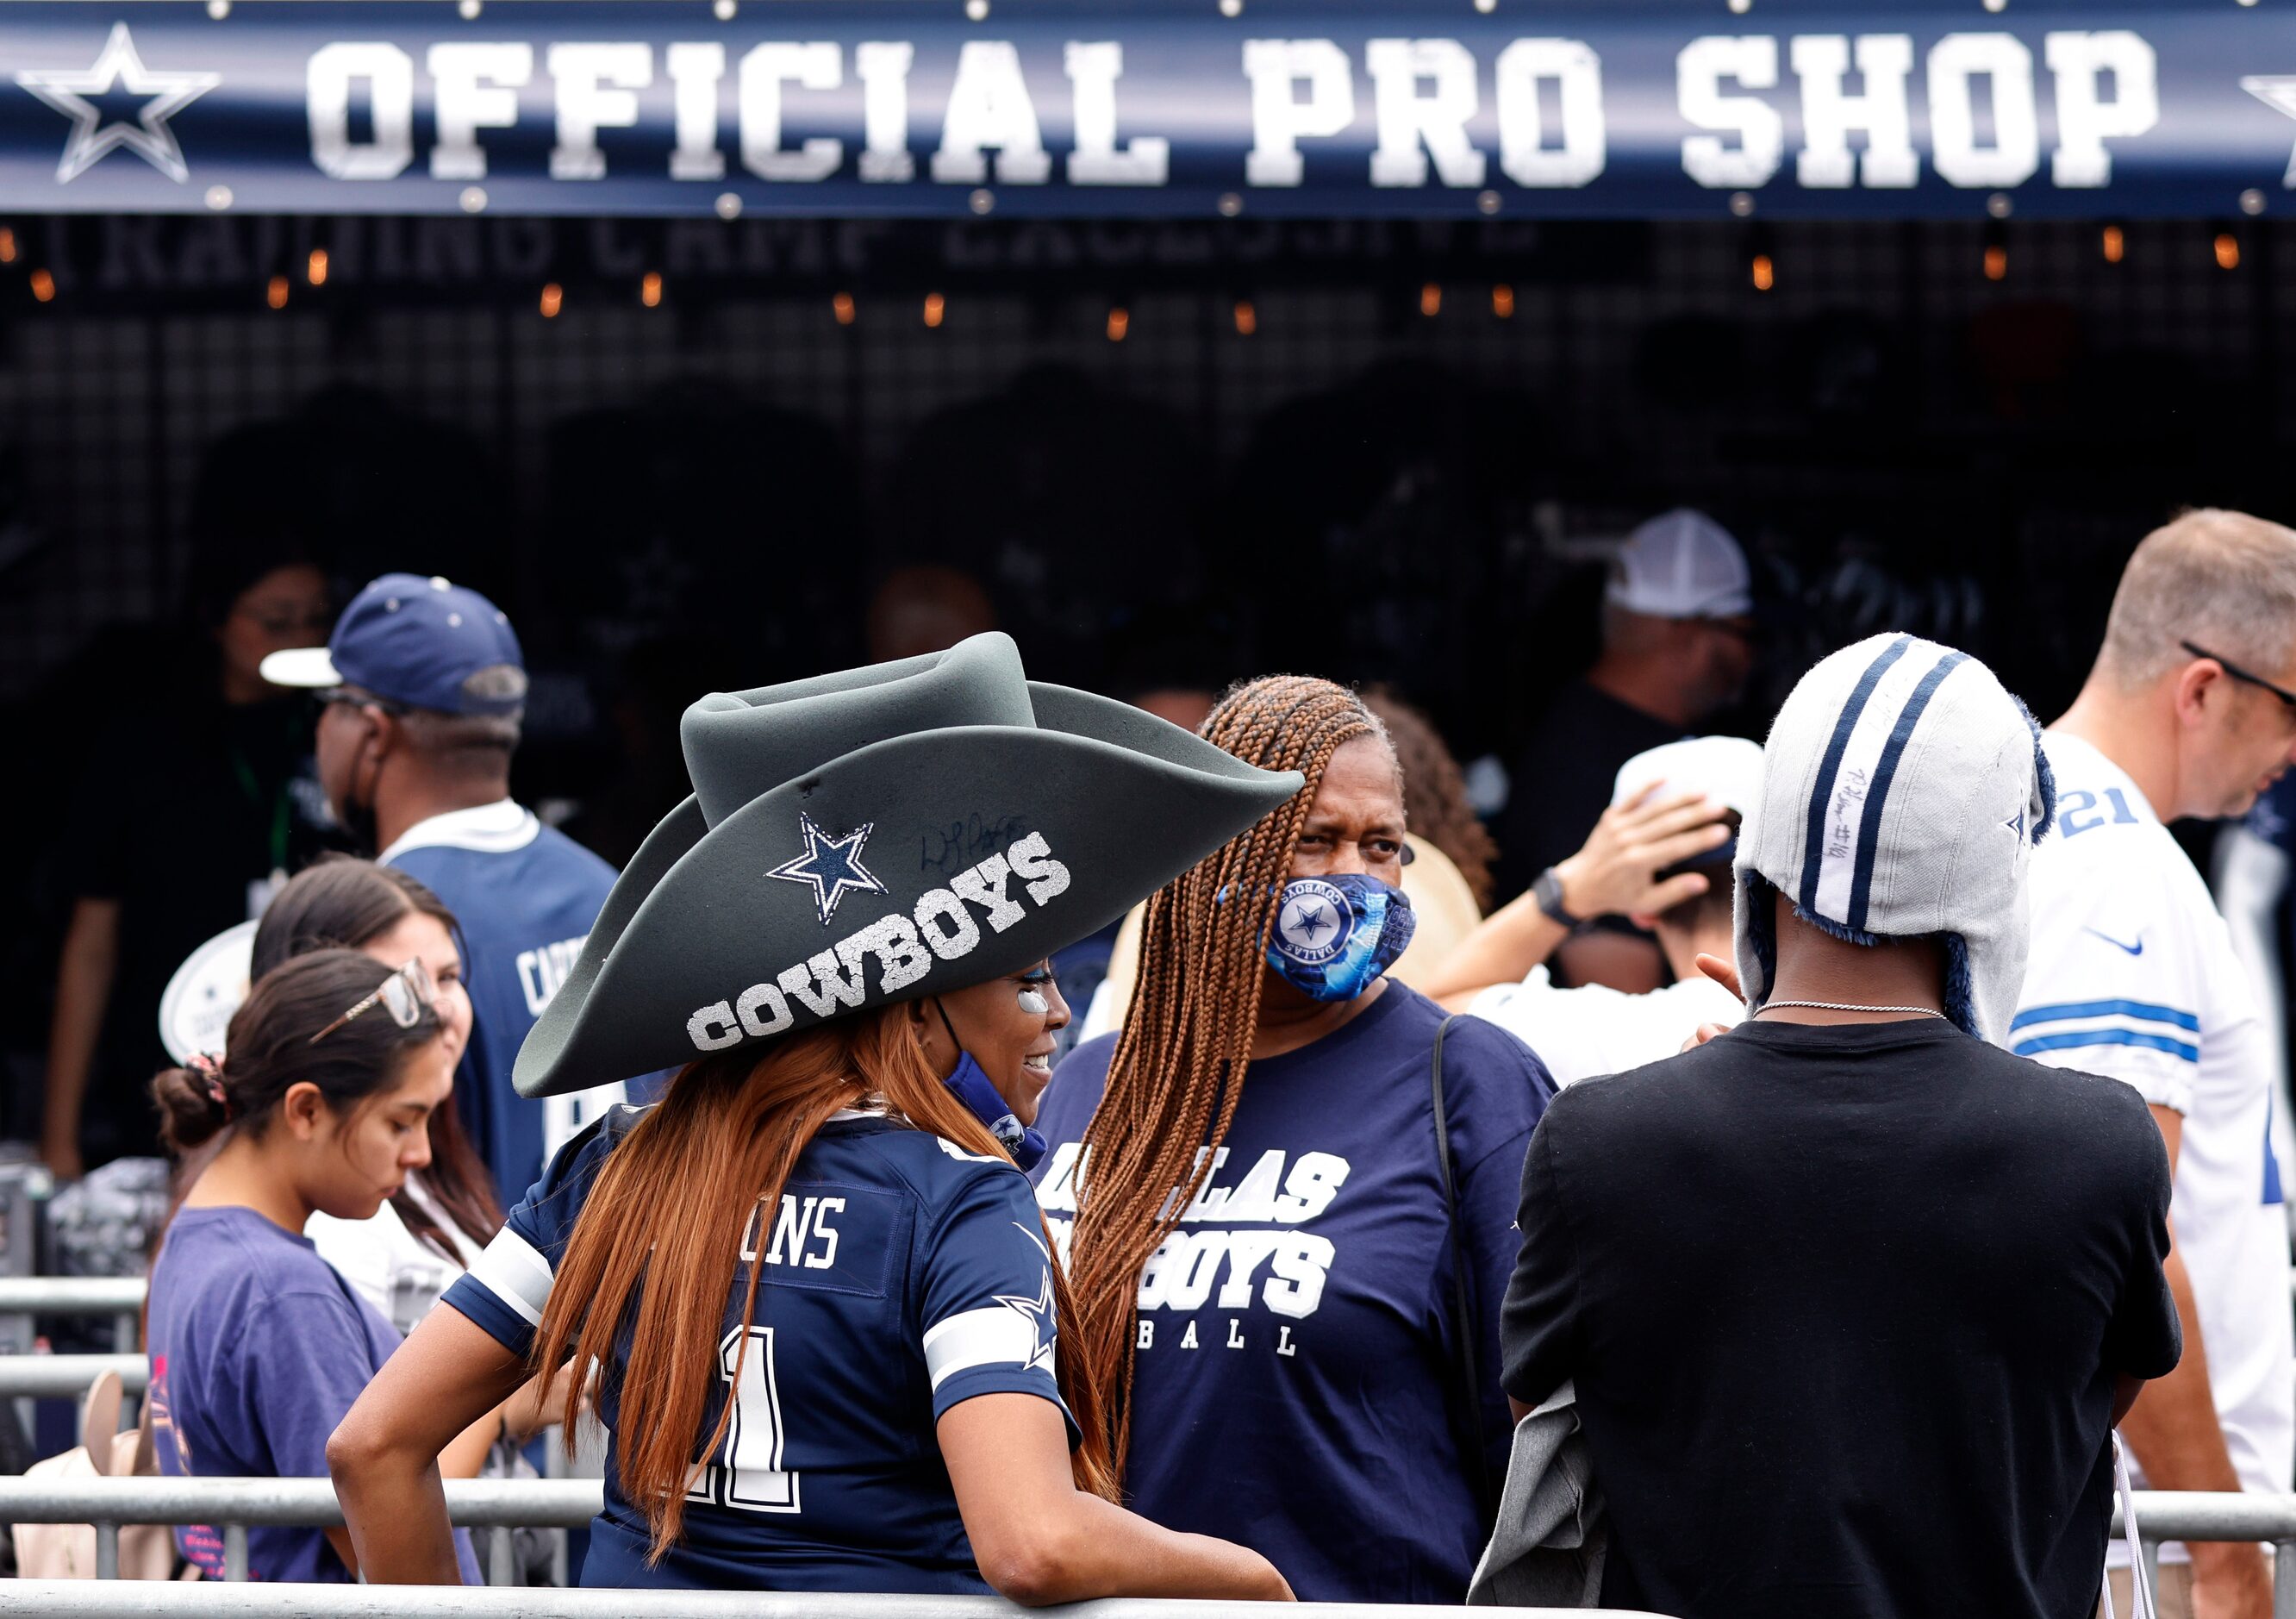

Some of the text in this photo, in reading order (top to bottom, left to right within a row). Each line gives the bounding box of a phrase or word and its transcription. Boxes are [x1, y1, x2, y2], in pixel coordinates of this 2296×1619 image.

[306, 30, 2159, 188] OFFICIAL PRO SHOP
[2057, 788, 2139, 839] 21
[1282, 882, 1341, 905] COWBOYS
[687, 831, 1070, 1051] COWBOYS
[1285, 943, 1336, 960] DALLAS
